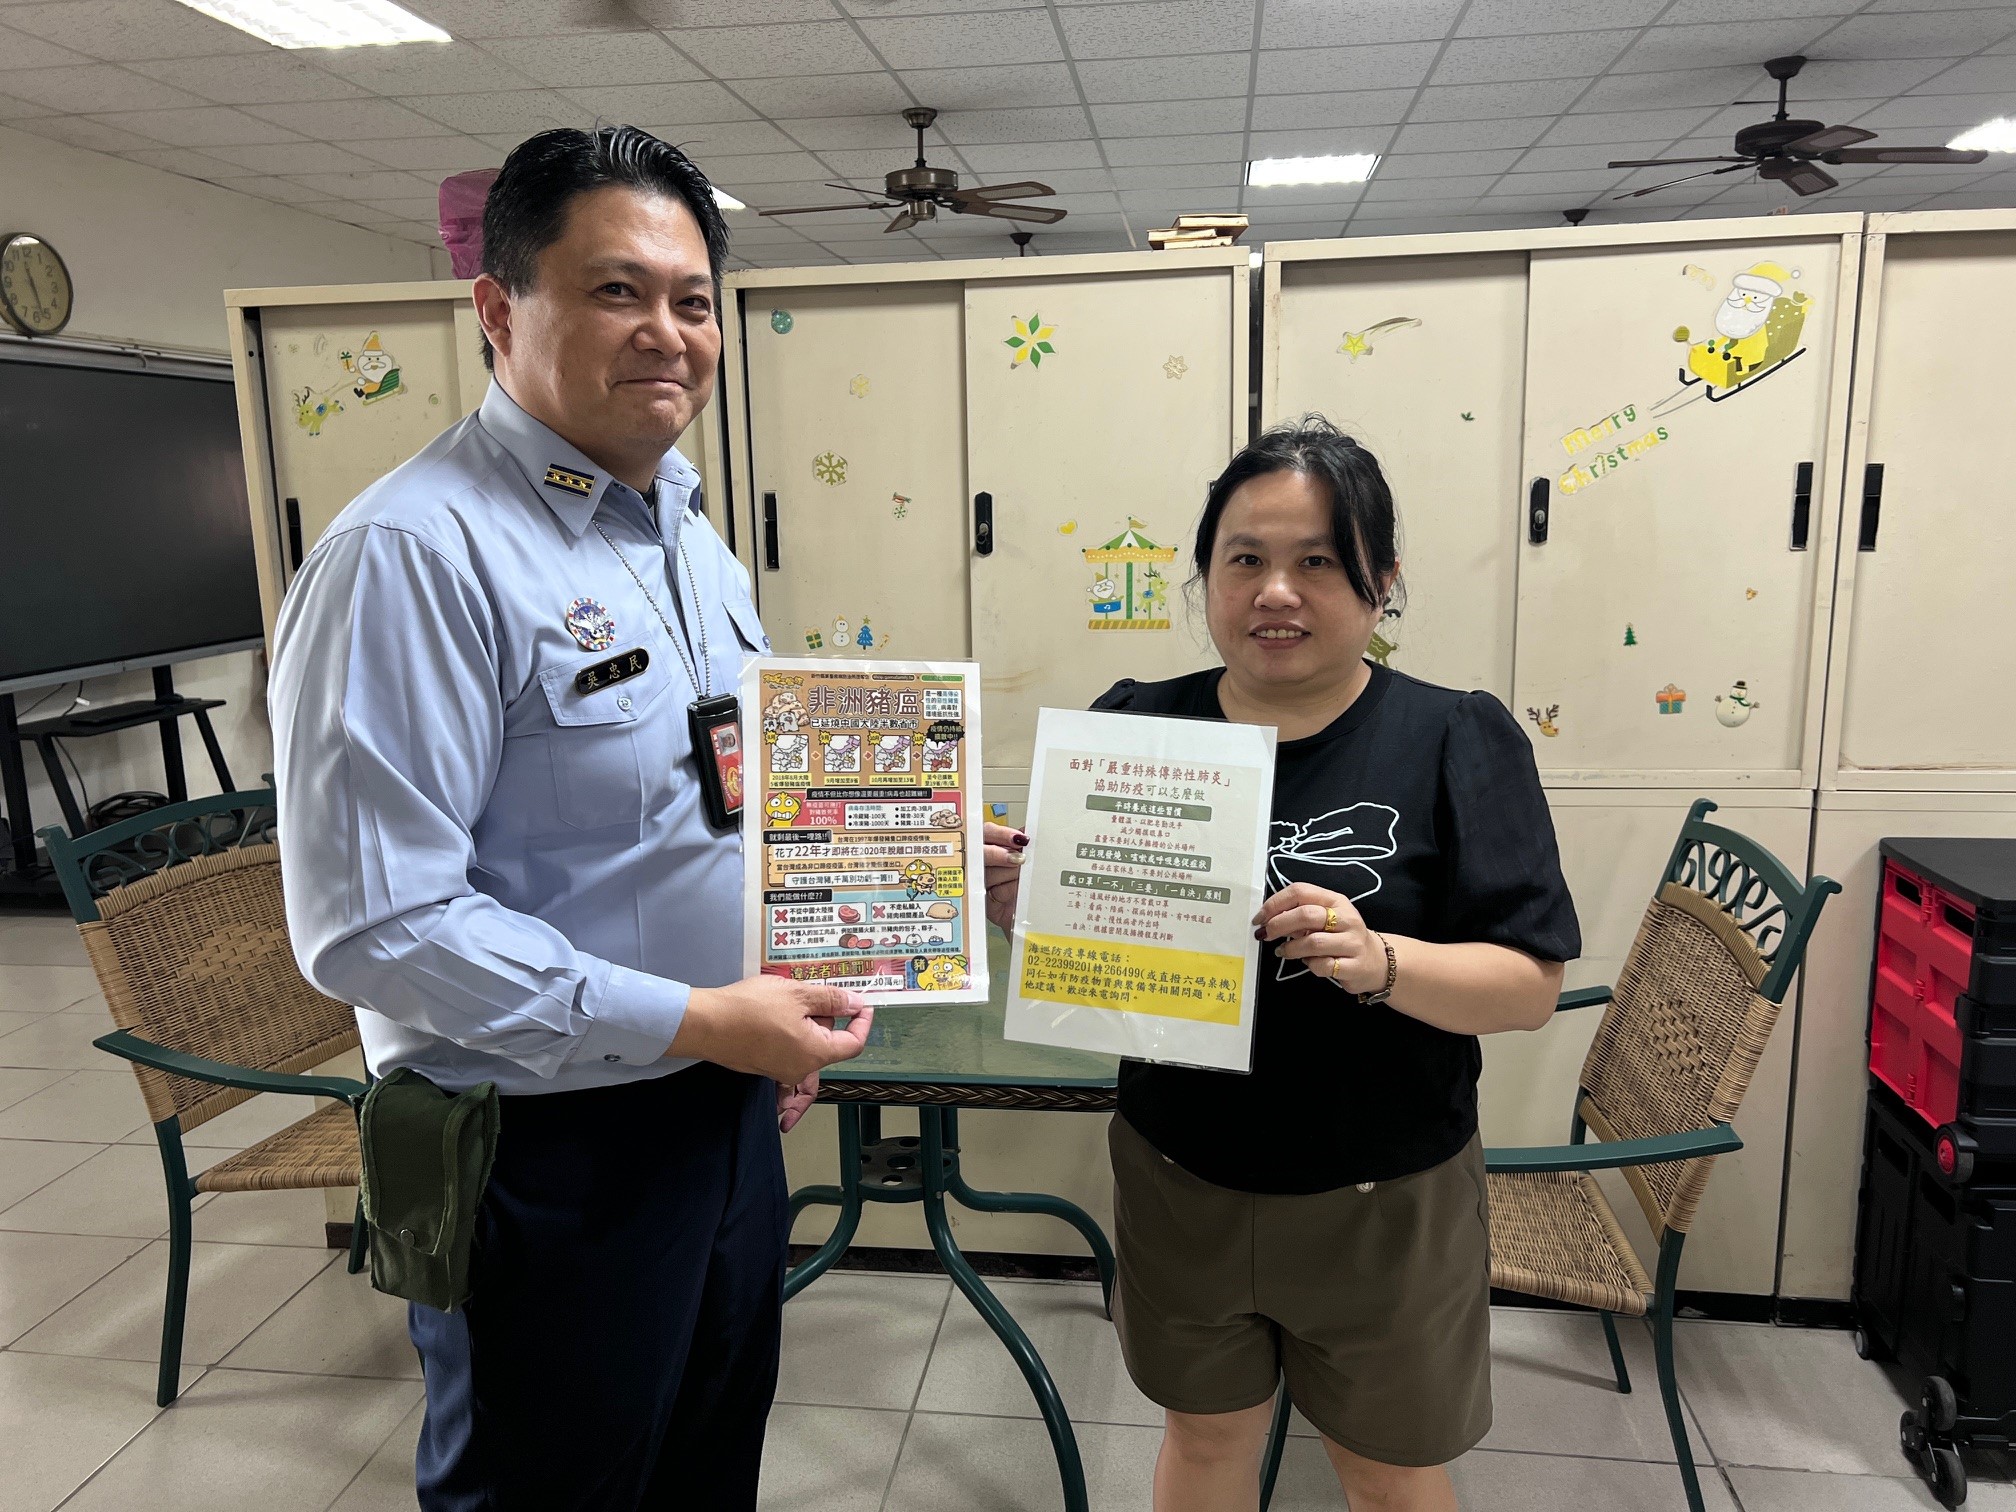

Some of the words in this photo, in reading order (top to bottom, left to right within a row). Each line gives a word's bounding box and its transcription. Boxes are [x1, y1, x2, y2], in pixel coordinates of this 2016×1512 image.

[45, 265, 53, 277] 2
[51, 281, 58, 294] 3
[51, 298, 57, 309] 4
[22, 305, 28, 317] 7
[33, 311, 41, 323] 6
[587, 654, 642, 689] 吳忠民
[809, 686, 920, 715] 非洲豬瘟
[810, 718, 919, 729] 已延燒中國大陸半數省市
[1069, 758, 1231, 787] 面對「嚴重特殊傳染性肺炎」
[1095, 778, 1205, 801] 協助防疫可以怎麼做
[809, 816, 837, 825] 100%
[1028, 943, 1130, 963] 海巡防疫專線電話：
